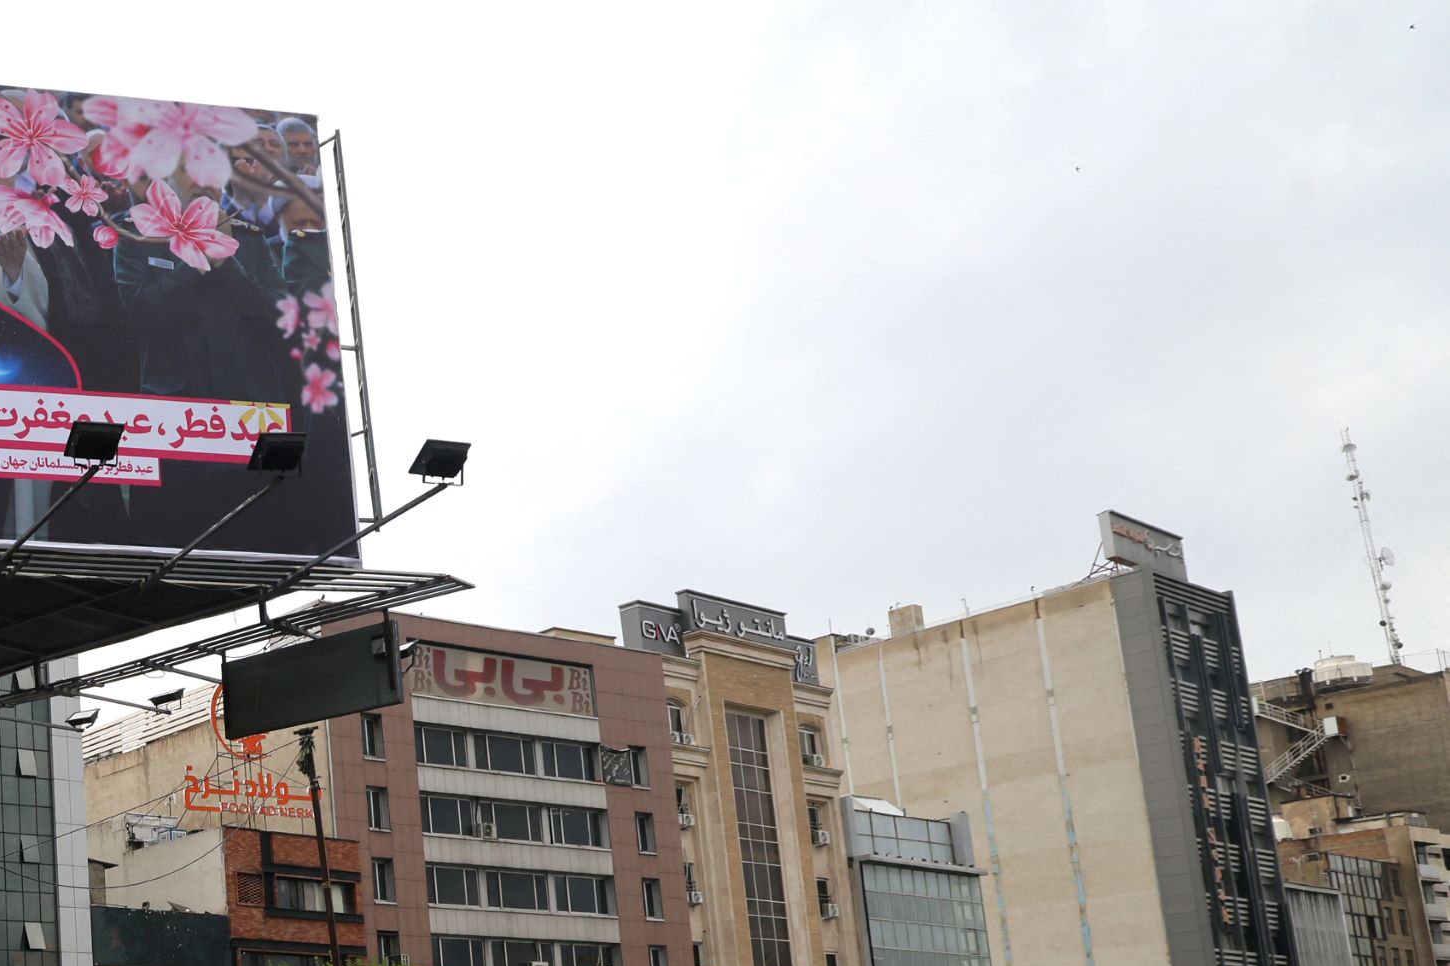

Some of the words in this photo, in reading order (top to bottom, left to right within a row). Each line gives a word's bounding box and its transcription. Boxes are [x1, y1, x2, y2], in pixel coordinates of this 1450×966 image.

[1, 455, 28, 471] جهان
[112, 460, 134, 476] فطر
[135, 463, 154, 476] عید
[692, 599, 731, 633] ژیوا
[736, 617, 785, 641] مانتو
[567, 668, 588, 691] Bi
[570, 691, 591, 714] Bi
